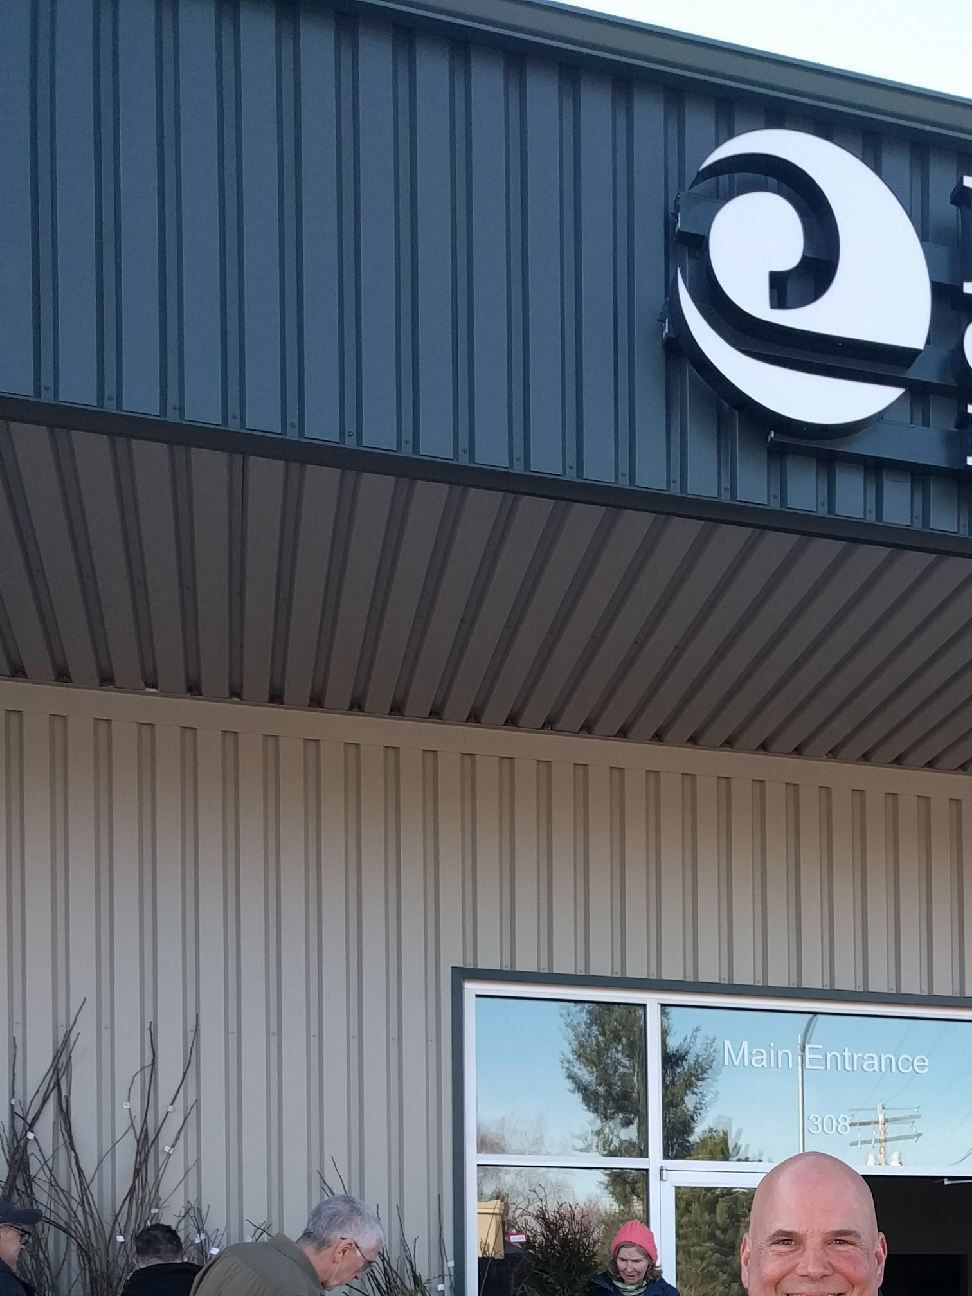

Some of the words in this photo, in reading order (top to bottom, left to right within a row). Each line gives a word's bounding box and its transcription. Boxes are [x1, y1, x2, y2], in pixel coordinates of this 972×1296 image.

[723, 1039, 793, 1069] Main
[804, 1043, 930, 1074] Entrance
[807, 1113, 850, 1136] 308
